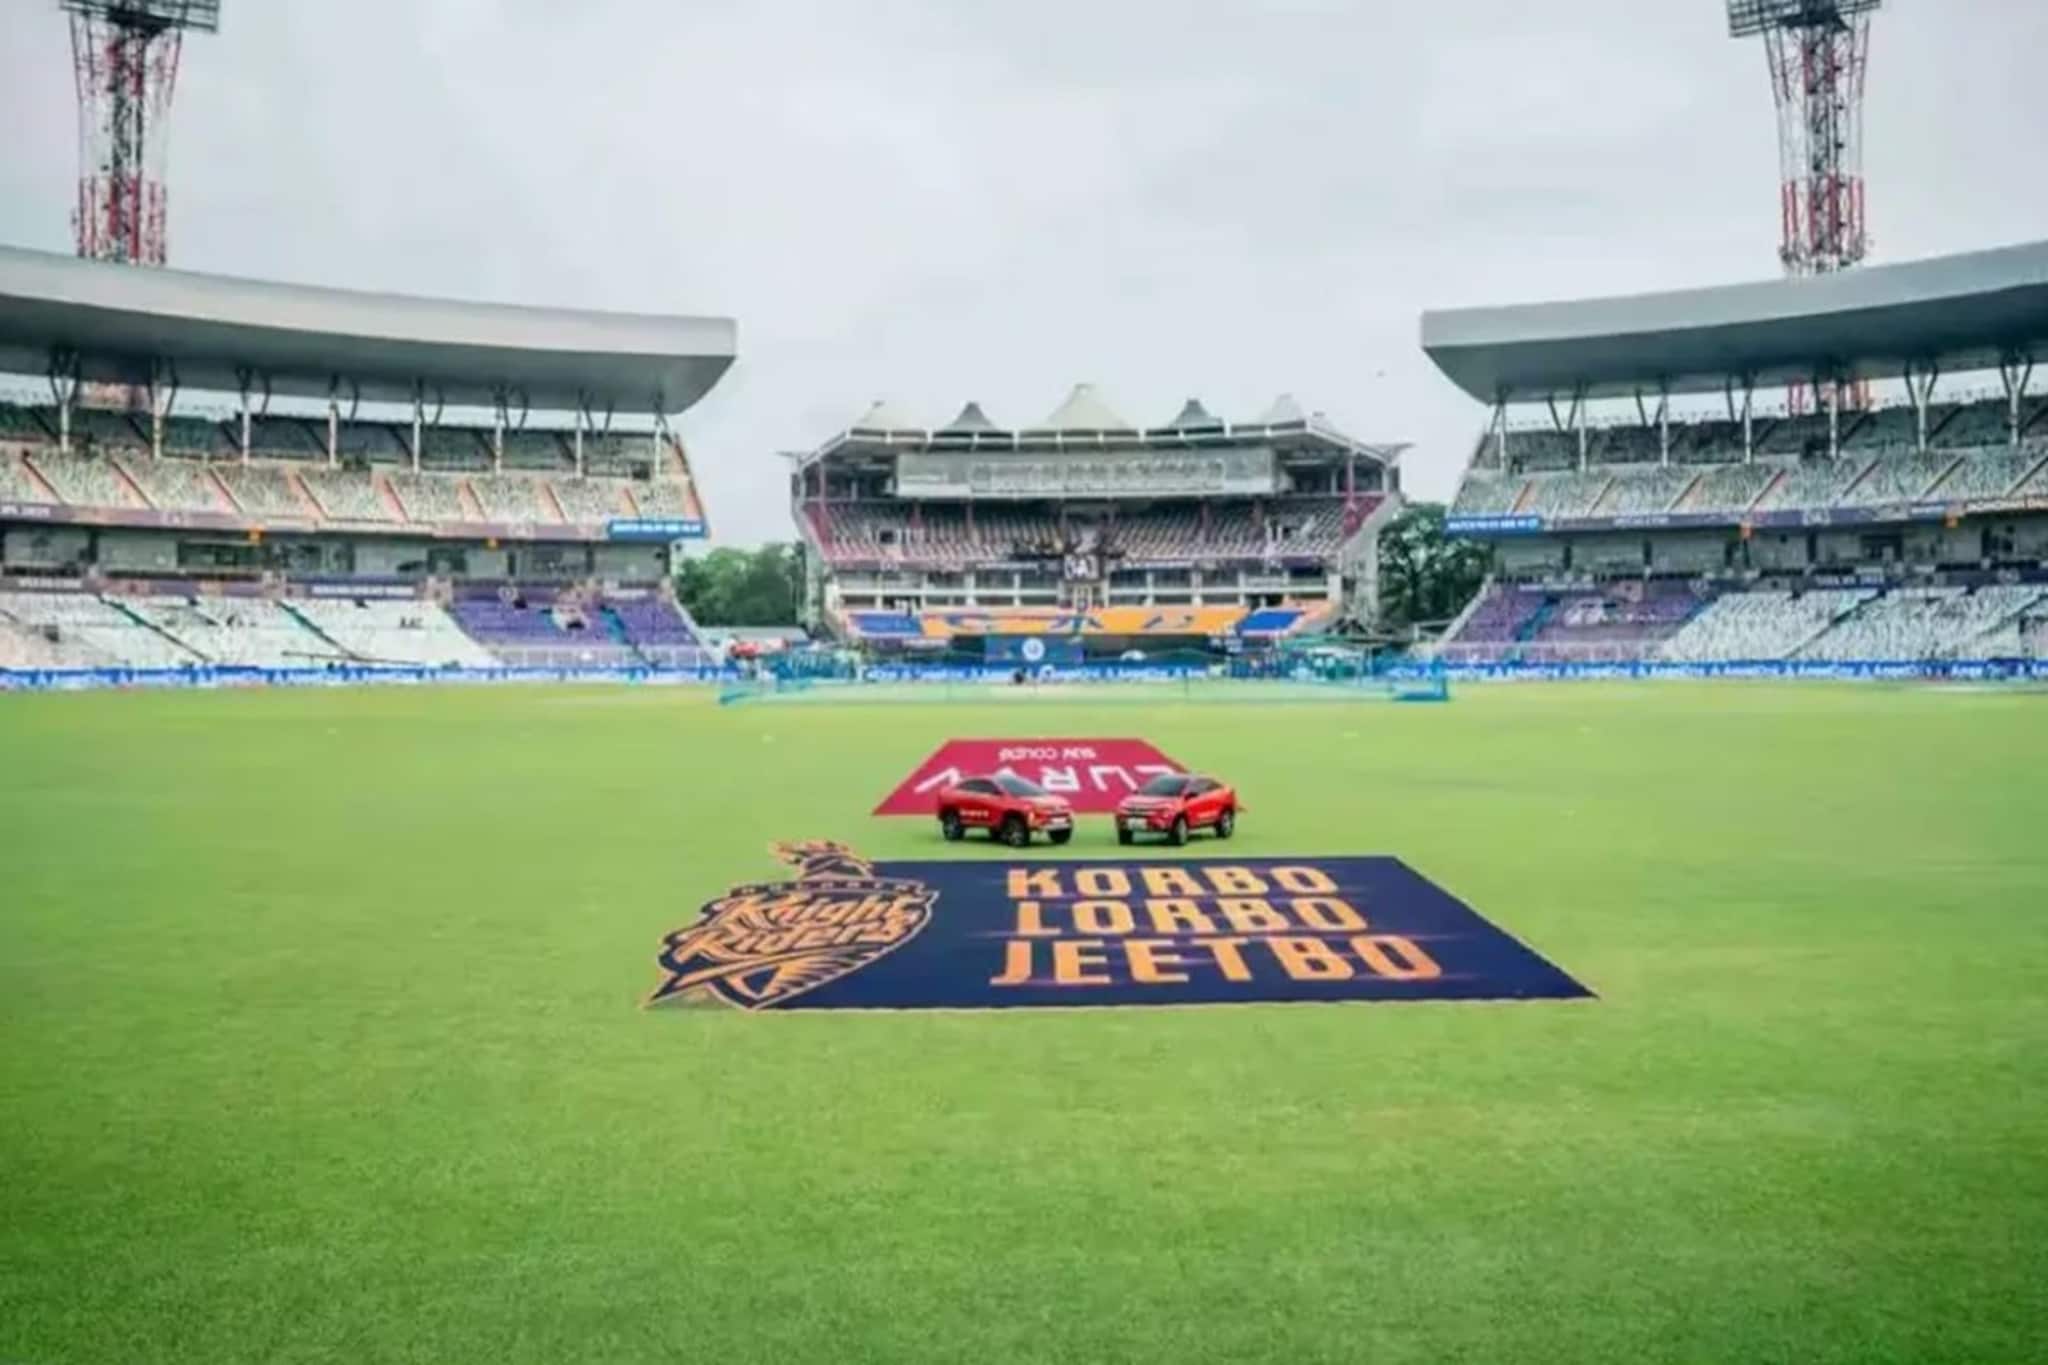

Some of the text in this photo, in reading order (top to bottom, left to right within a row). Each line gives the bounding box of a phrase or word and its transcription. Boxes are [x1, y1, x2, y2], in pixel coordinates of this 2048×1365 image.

[1007, 866, 1338, 898] KORBO
[1017, 898, 1368, 934] LORBO
[990, 935, 1442, 986] JEETBO
